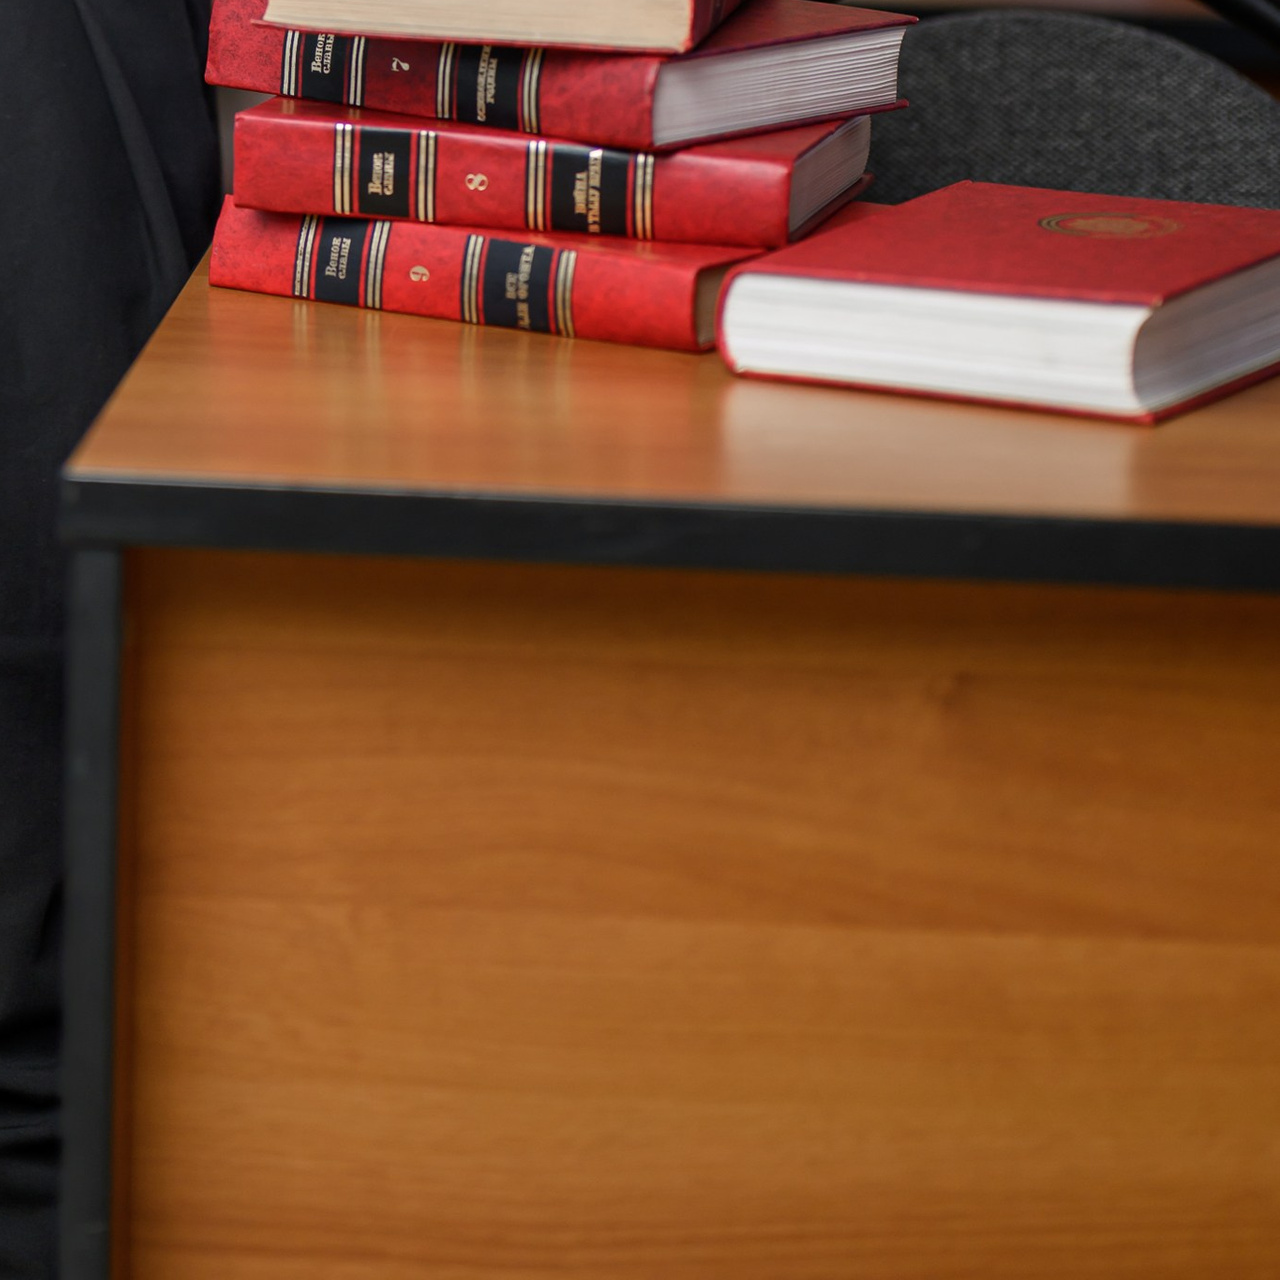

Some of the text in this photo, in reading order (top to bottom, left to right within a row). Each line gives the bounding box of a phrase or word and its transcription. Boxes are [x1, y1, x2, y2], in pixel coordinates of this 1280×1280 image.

[311, 33, 326, 73] Венок
[323, 34, 335, 74] славы
[391, 57, 410, 72] 7
[465, 173, 489, 191] 8
[325, 237, 341, 278] Венок
[338, 237, 352, 280] славы
[409, 265, 430, 282] 9
